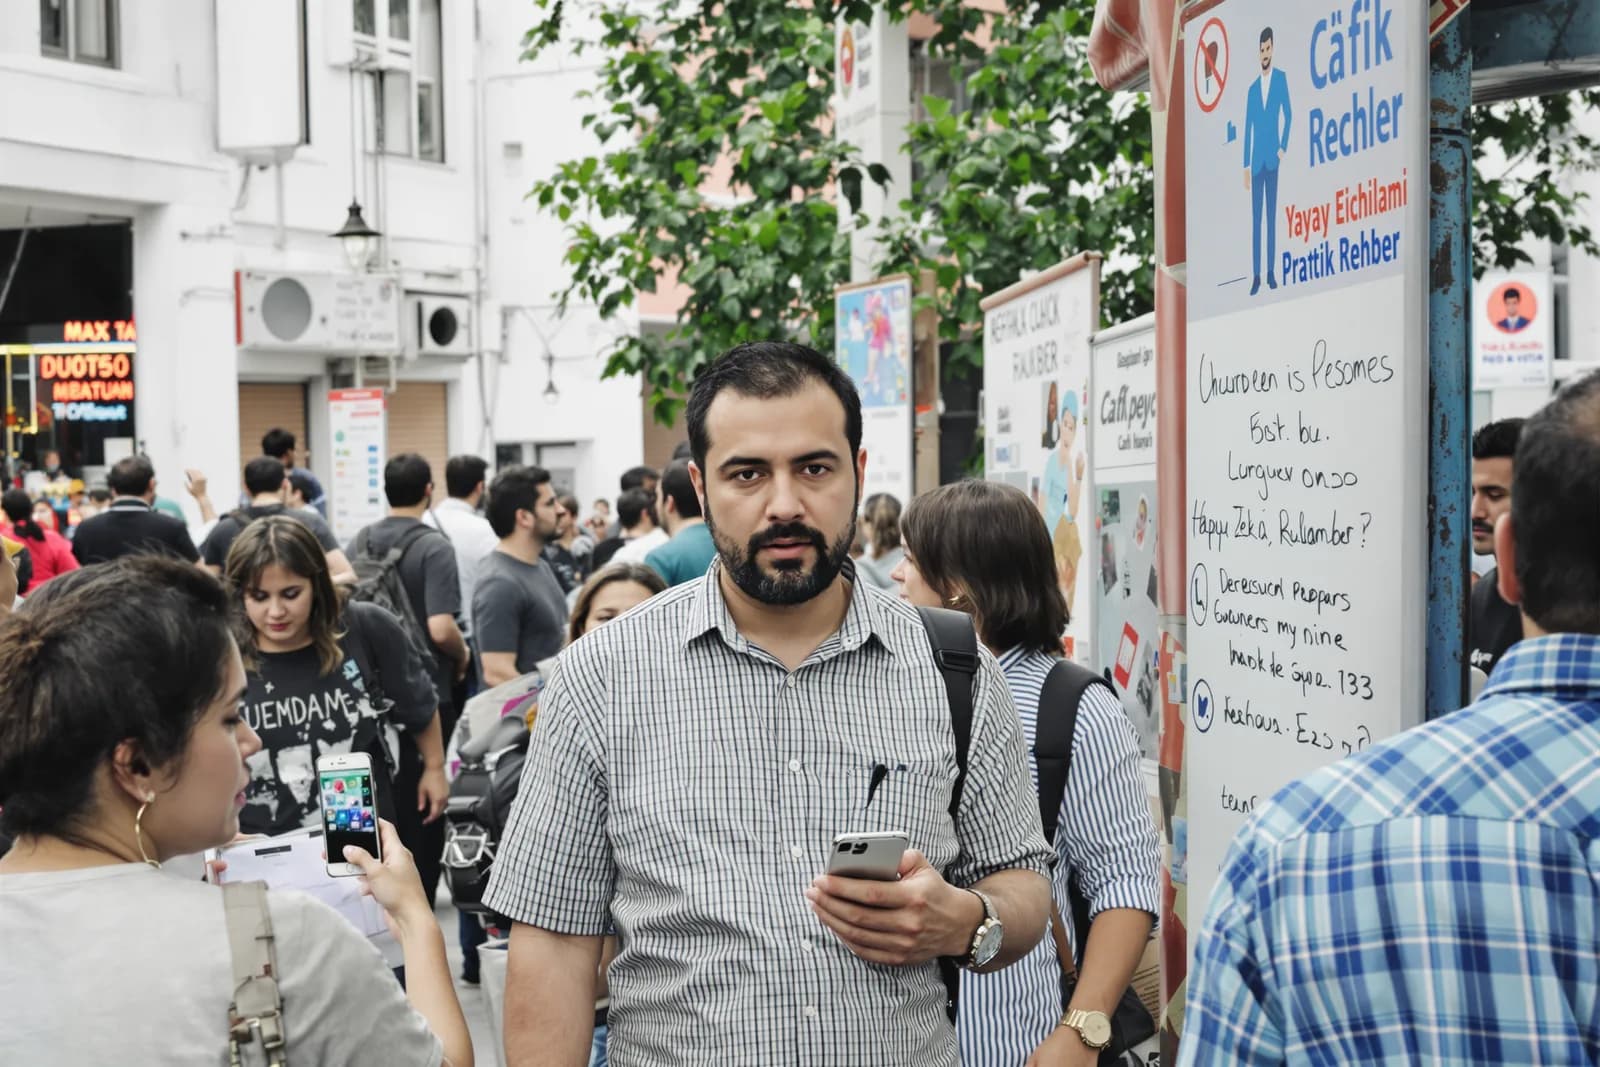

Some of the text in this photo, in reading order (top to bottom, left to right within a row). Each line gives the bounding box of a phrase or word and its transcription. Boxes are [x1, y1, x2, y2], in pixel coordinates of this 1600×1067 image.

[1309, 86, 1403, 168] Rechler
[1285, 167, 1407, 243] Yayay Eichilami
[1282, 228, 1400, 286] Prattik Rehber
[64, 320, 111, 342] MAX
[1277, 620, 1297, 650] my
[1338, 669, 1374, 701] 133
